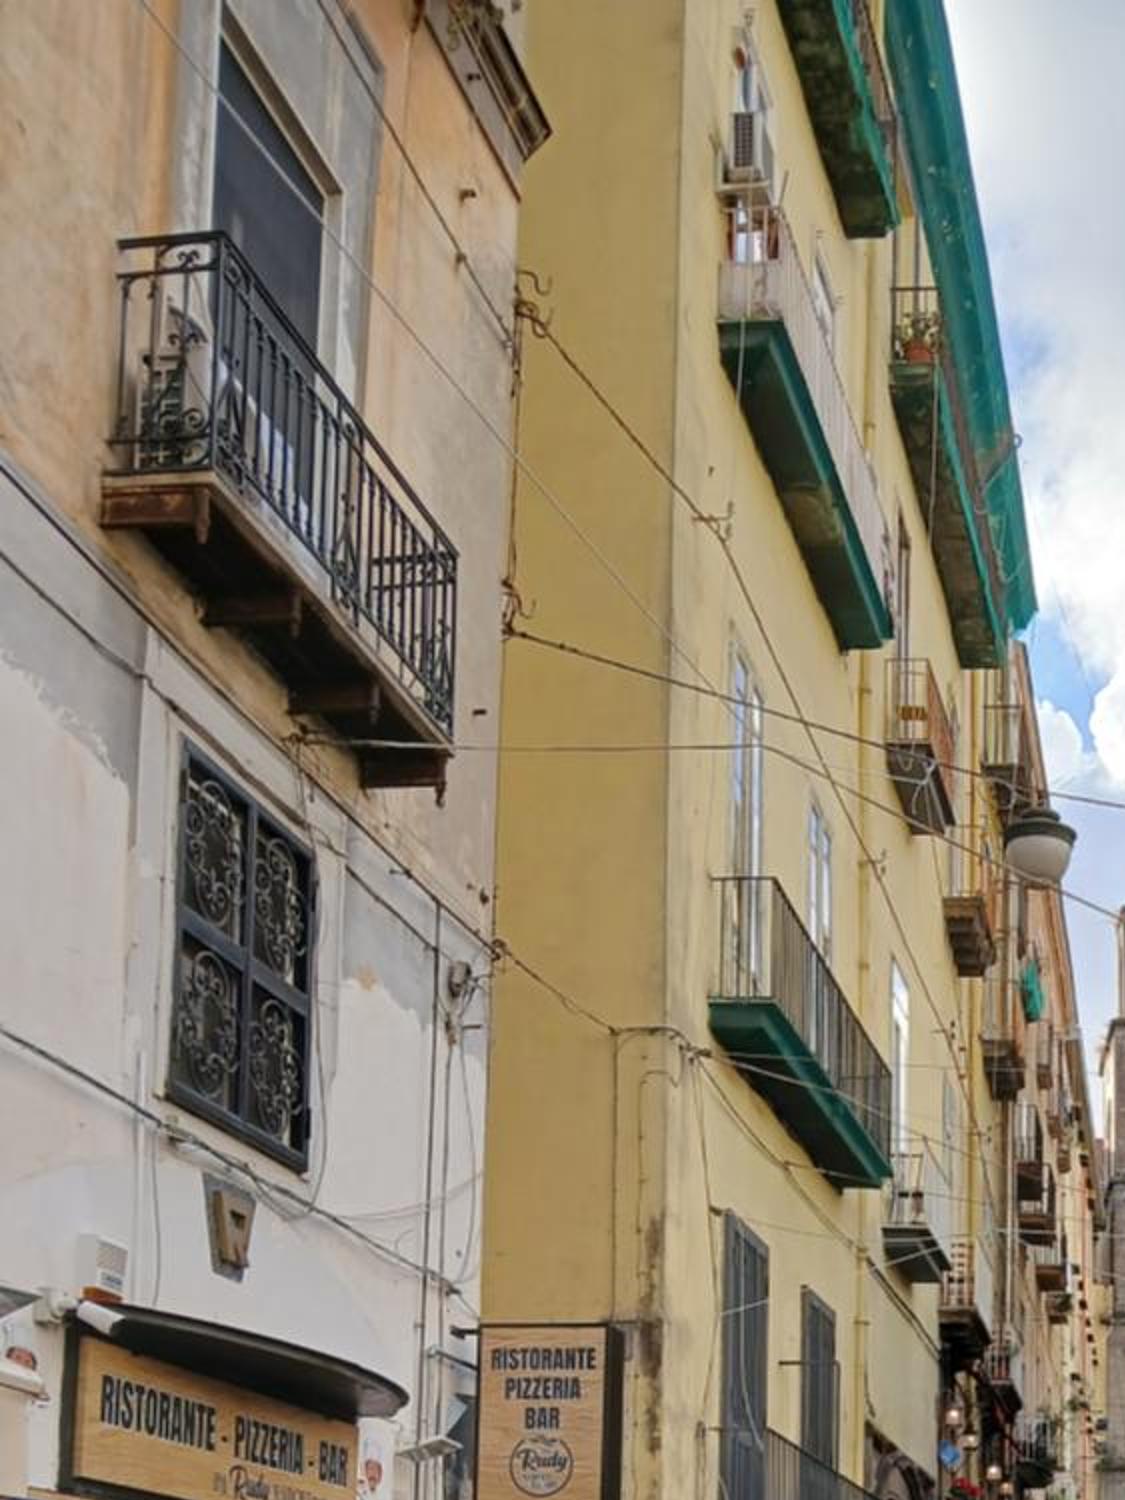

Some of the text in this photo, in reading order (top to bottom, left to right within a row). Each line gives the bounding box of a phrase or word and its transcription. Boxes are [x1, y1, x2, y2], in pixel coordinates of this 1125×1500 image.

[490, 1346, 597, 1371] RISTORANTE
[504, 1376, 582, 1400] PIZZERIA
[524, 1406, 561, 1430] BAR
[100, 1374, 216, 1452] RISTORANTE
[233, 1414, 304, 1475] PIZZERIA
[318, 1439, 348, 1488] BAR
[516, 1448, 569, 1473] Rudy
